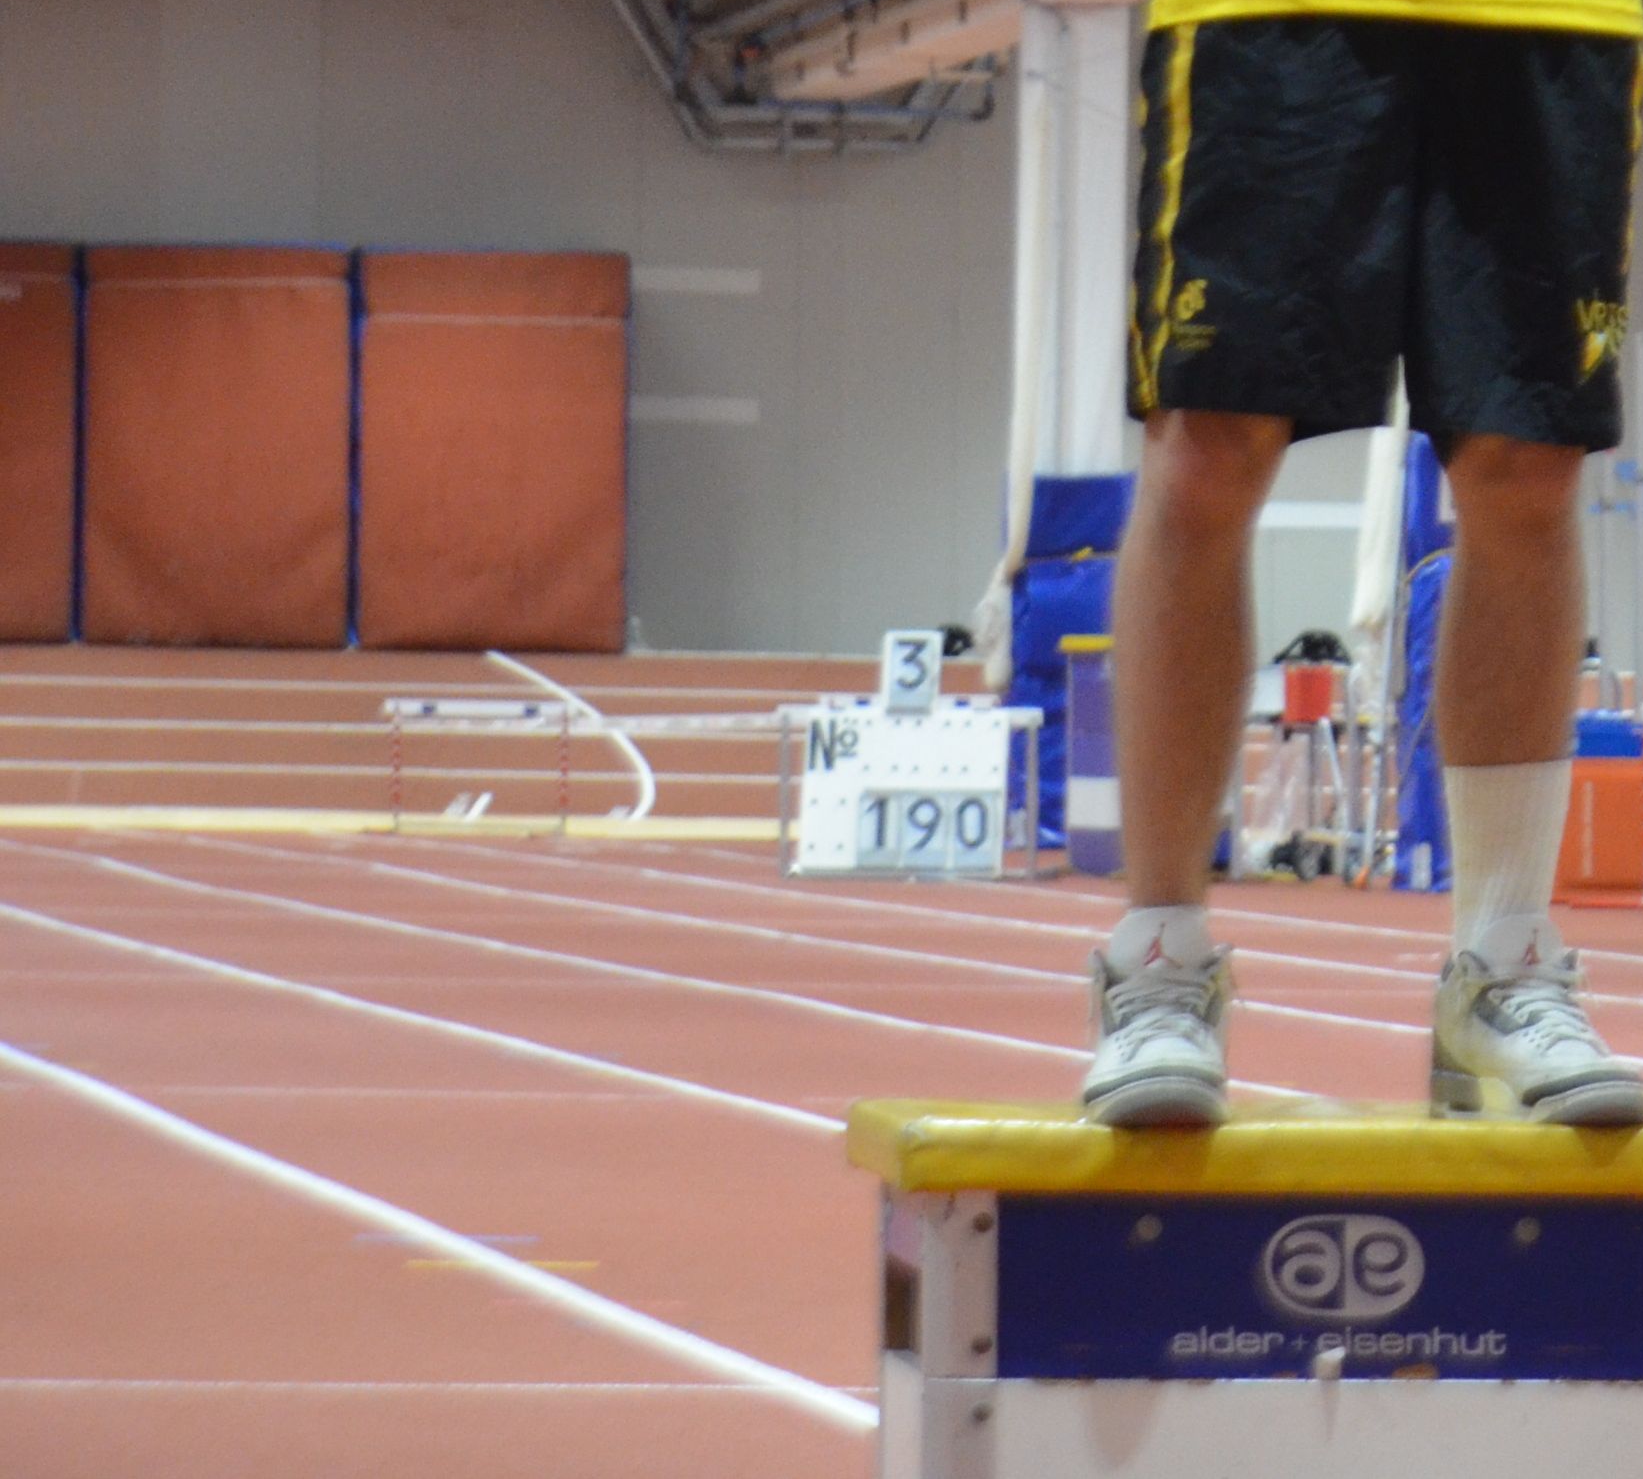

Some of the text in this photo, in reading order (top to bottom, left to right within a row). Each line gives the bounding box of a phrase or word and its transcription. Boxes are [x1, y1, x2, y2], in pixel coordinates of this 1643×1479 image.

[896, 638, 928, 690] 3
[866, 797, 989, 852] 190
[1172, 1326, 1285, 1355] alder
[1317, 1327, 1507, 1357] eisenhut
